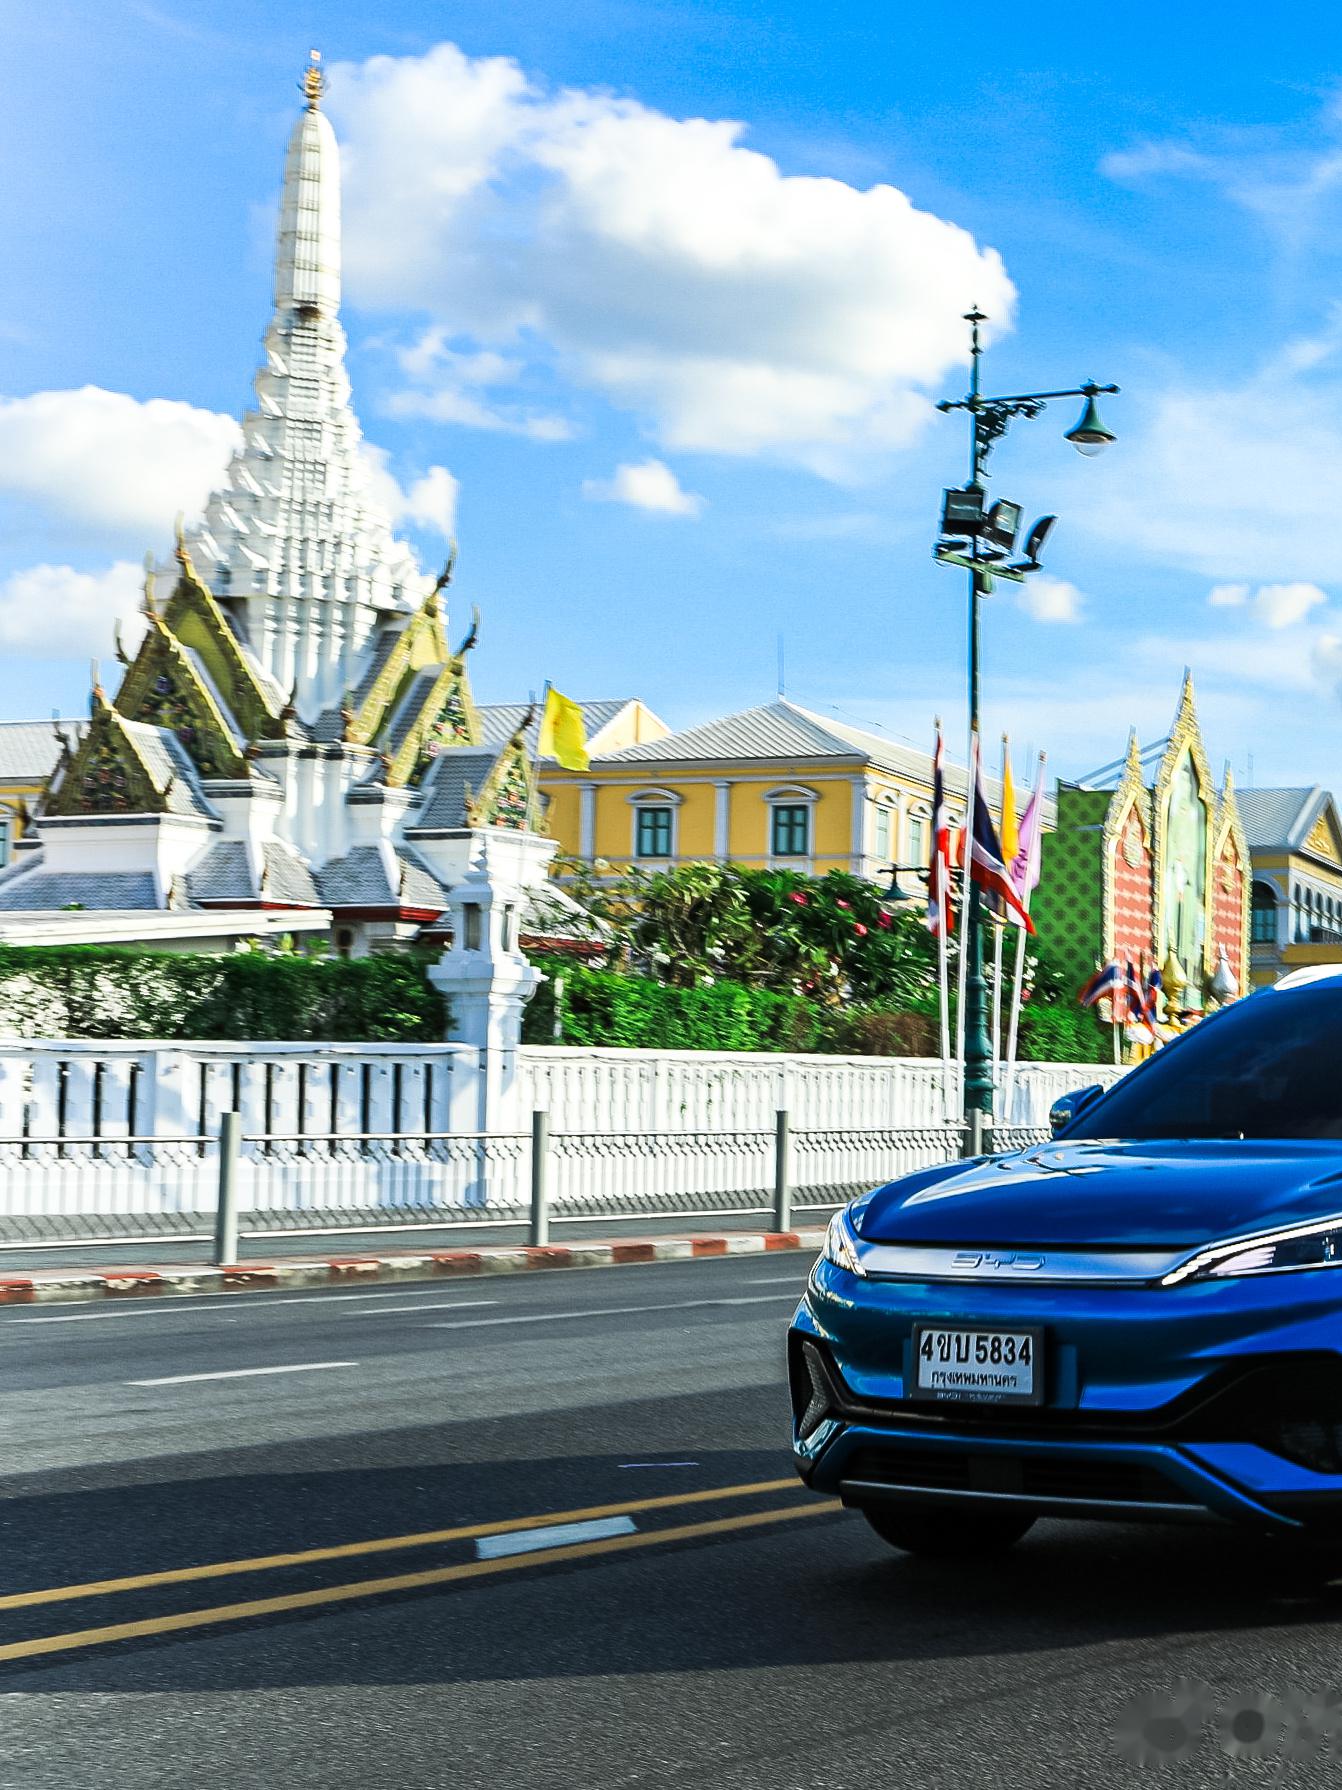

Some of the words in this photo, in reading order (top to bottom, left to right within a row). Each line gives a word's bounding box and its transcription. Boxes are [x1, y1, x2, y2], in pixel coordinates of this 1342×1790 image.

[951, 1252, 1046, 1270] BYD
[975, 1335, 1031, 1366] 5834
[931, 1371, 1018, 1388] กรุงเทพมหานคร
